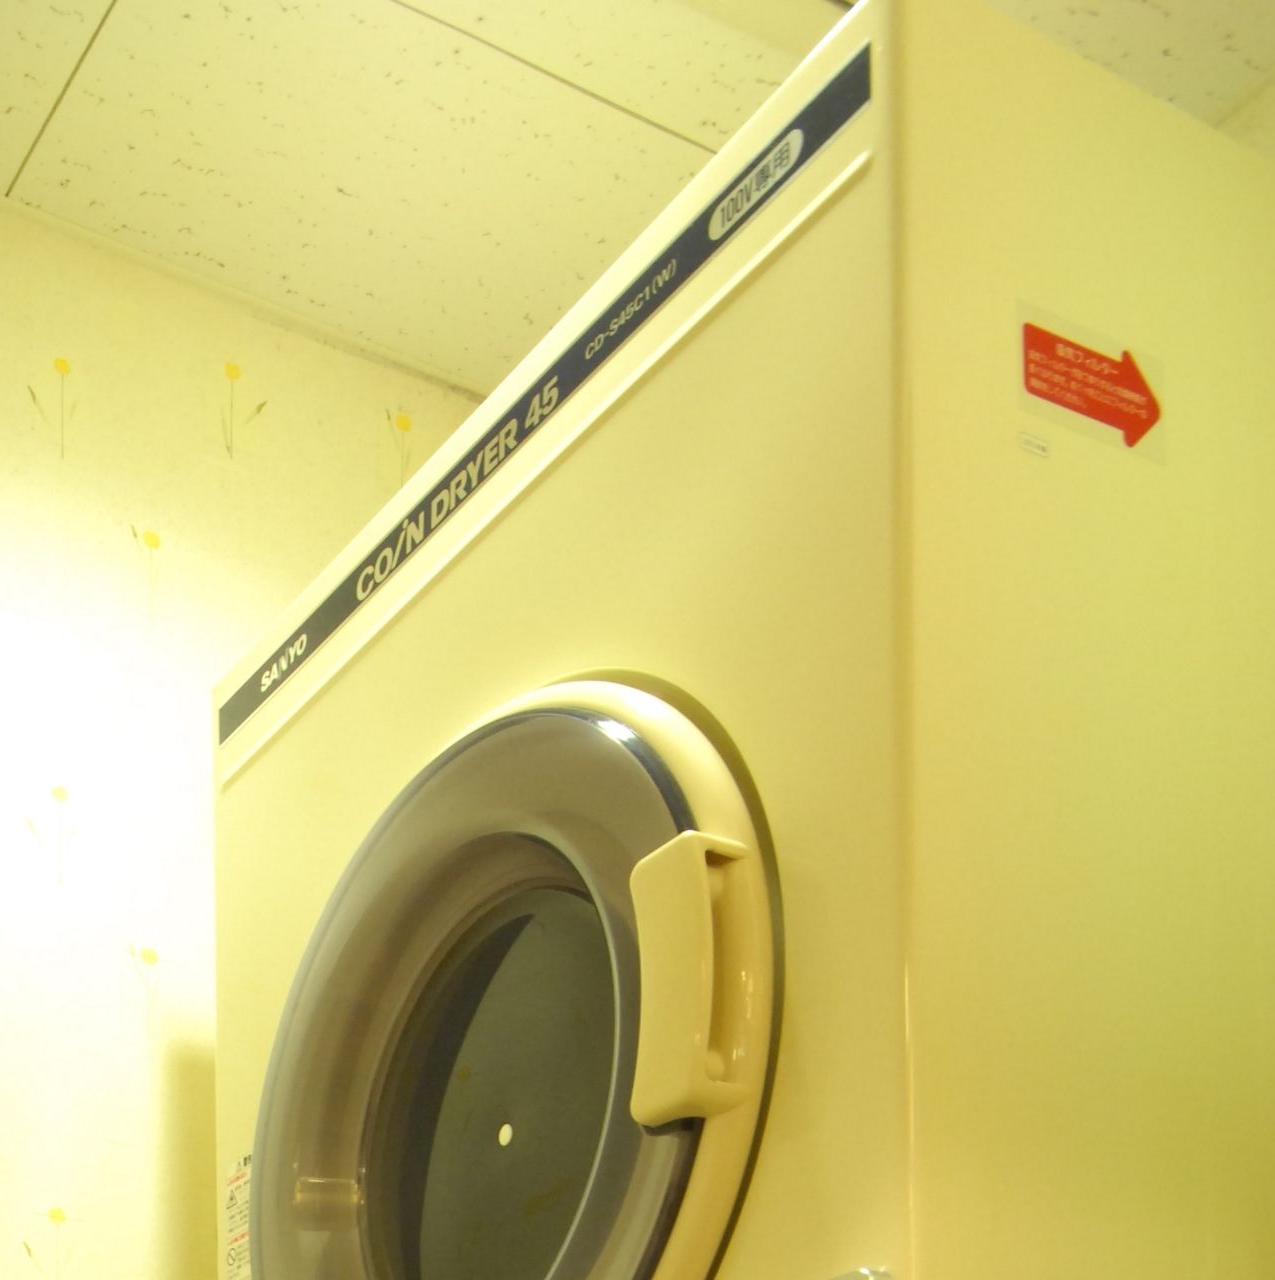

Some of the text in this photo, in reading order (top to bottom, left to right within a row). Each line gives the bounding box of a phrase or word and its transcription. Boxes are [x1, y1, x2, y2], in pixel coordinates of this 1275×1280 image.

[431, 418, 518, 529] DRYER
[526, 376, 559, 429] 45
[261, 633, 307, 692] SANYO
